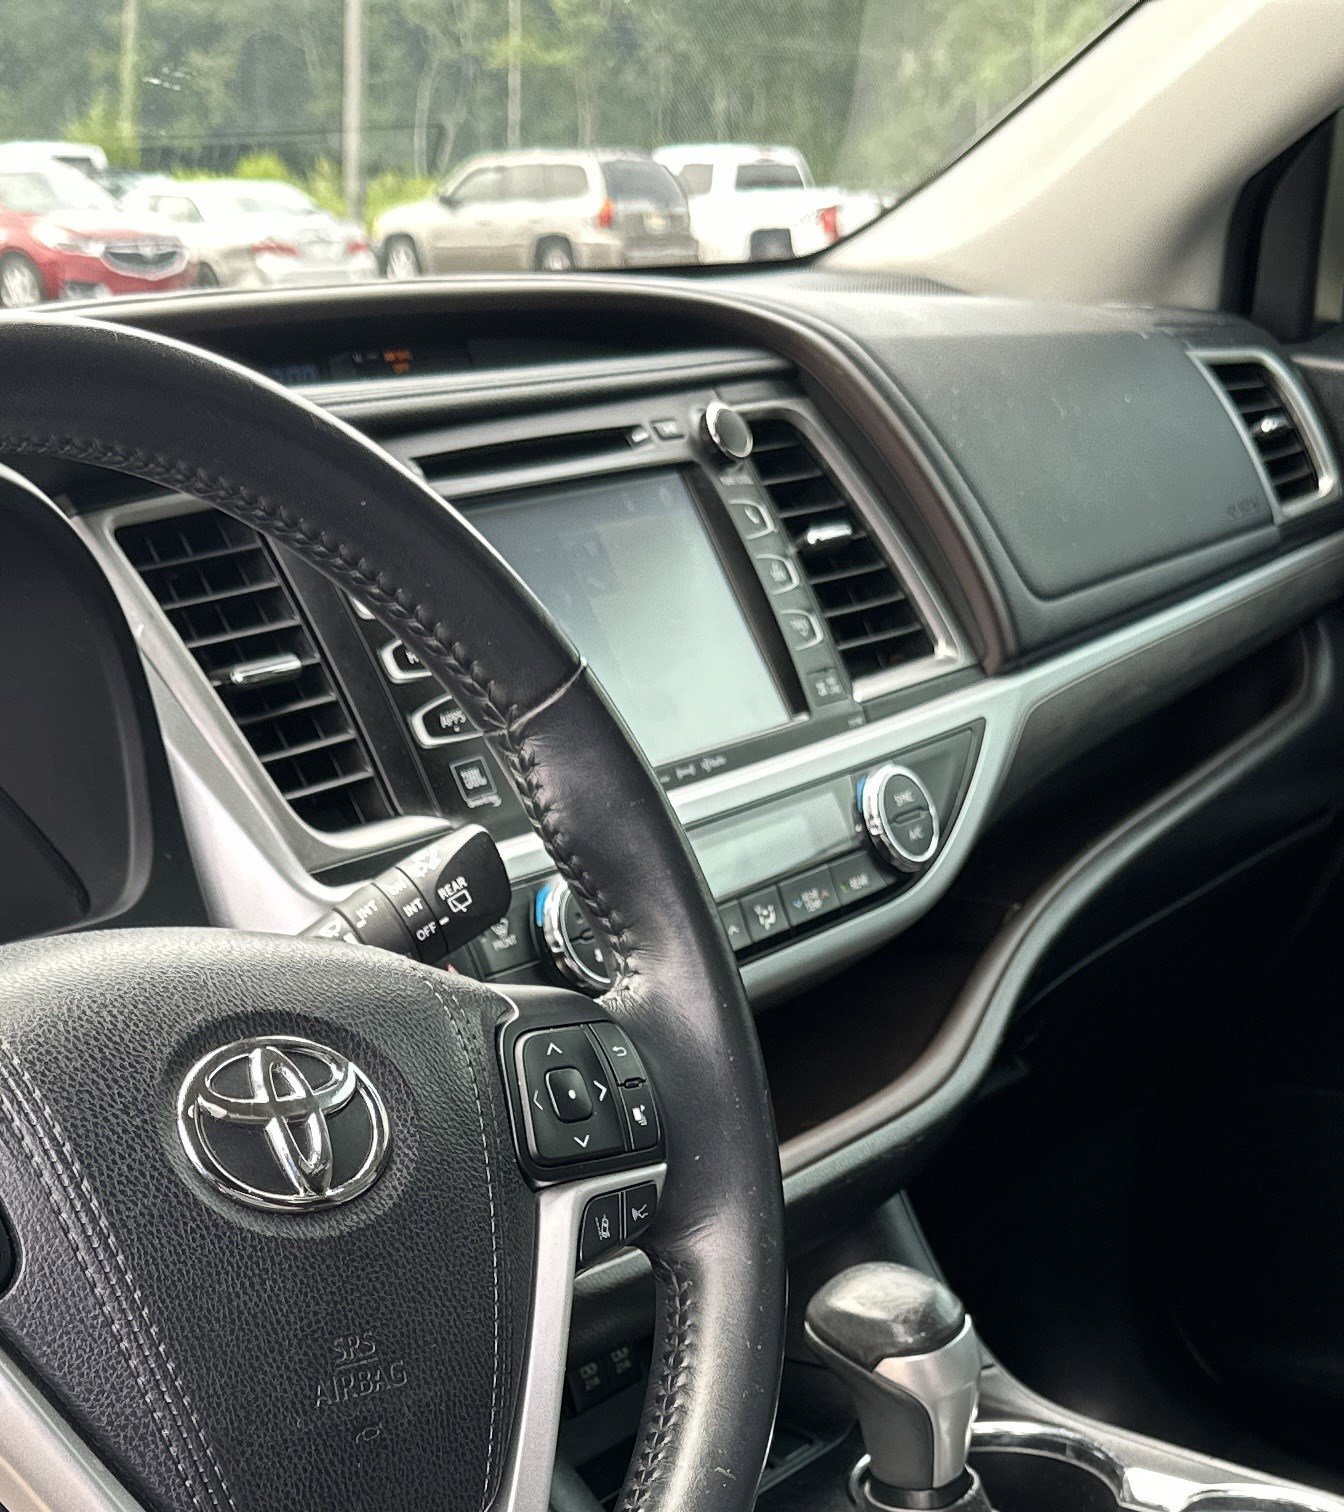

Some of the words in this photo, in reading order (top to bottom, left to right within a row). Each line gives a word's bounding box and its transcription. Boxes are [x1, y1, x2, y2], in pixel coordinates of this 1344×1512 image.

[437, 876, 468, 901] REAR
[402, 897, 424, 917] INT
[415, 921, 437, 942] OFF
